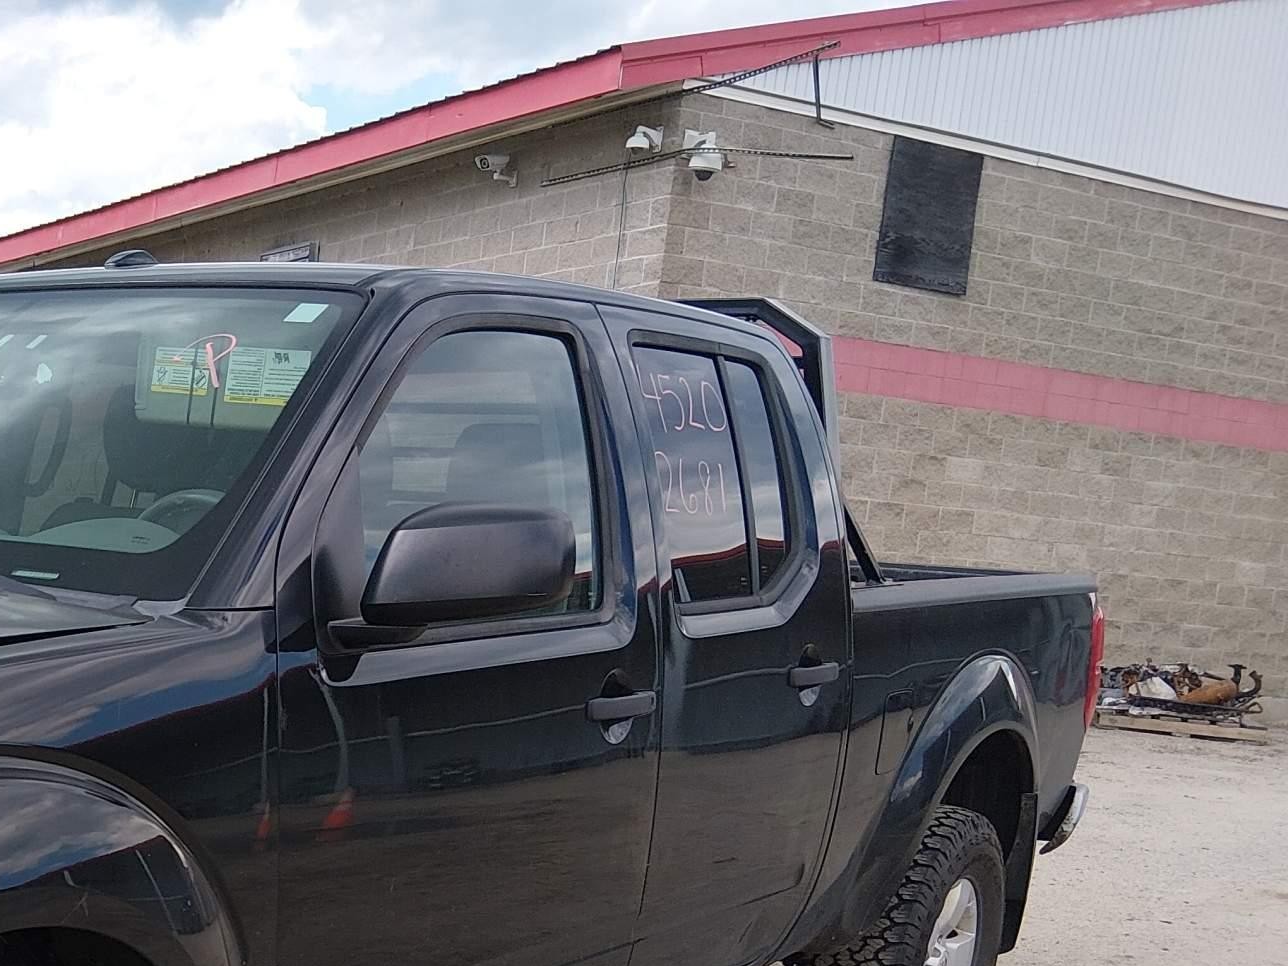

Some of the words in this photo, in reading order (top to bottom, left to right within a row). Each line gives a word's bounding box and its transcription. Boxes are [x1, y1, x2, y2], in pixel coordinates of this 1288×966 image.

[173, 333, 237, 388] P
[636, 364, 727, 432] 4520
[654, 451, 726, 517] 2681
